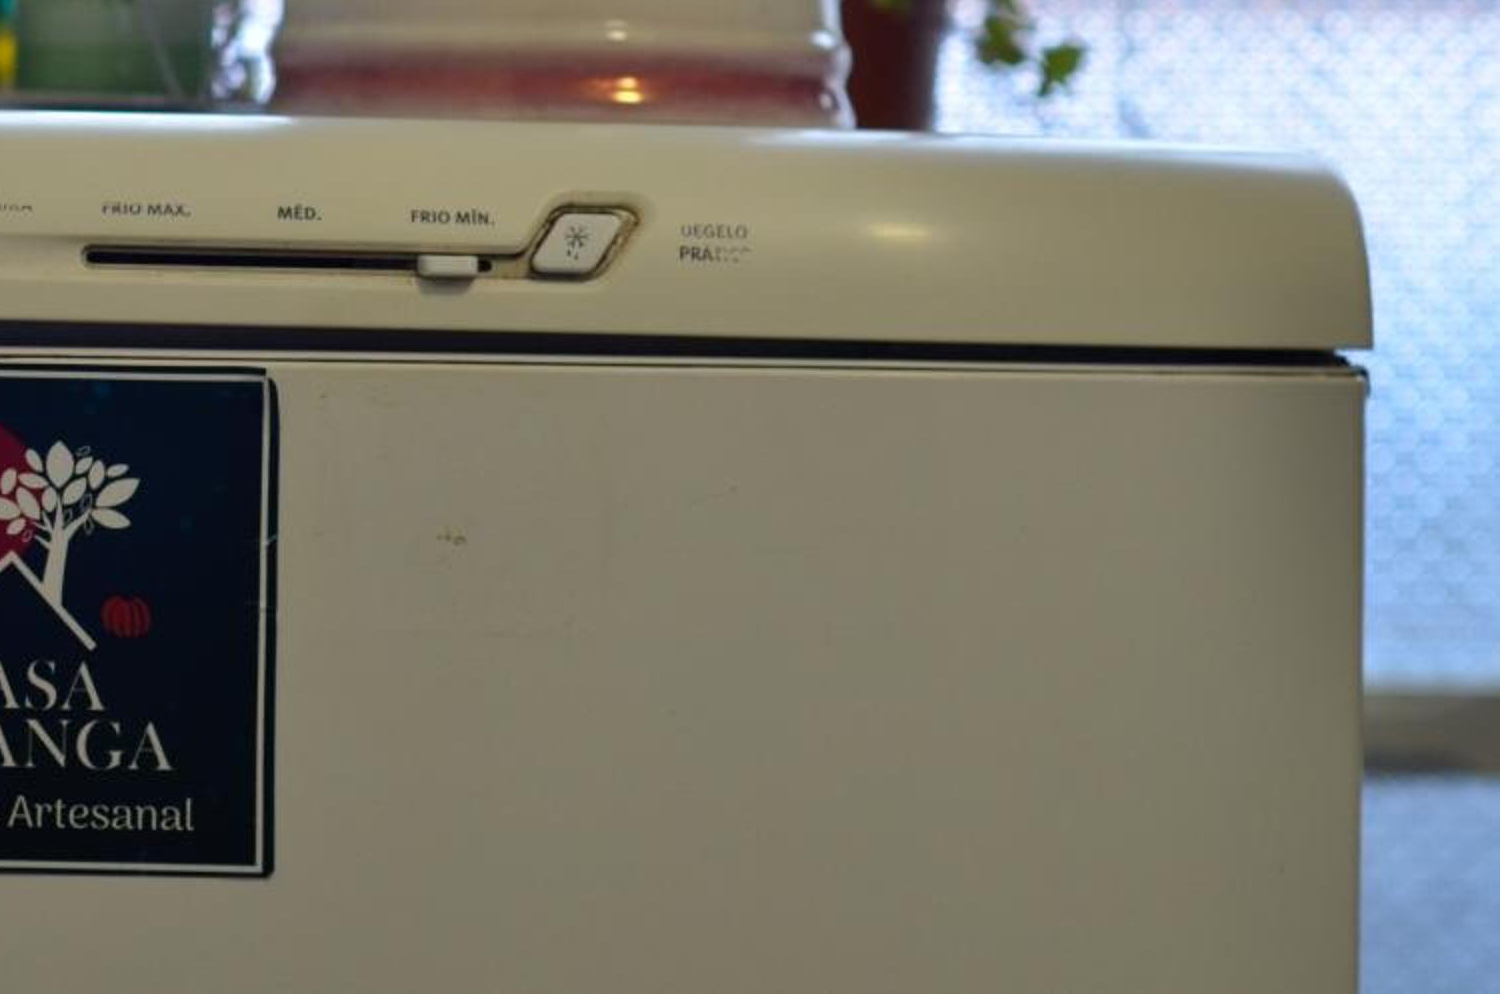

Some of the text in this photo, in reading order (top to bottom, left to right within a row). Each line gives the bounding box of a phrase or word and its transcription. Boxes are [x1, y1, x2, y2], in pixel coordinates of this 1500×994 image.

[277, 202, 322, 221] MÉD.
[411, 209, 451, 224] FRIO
[6, 794, 195, 832] Artesanal
